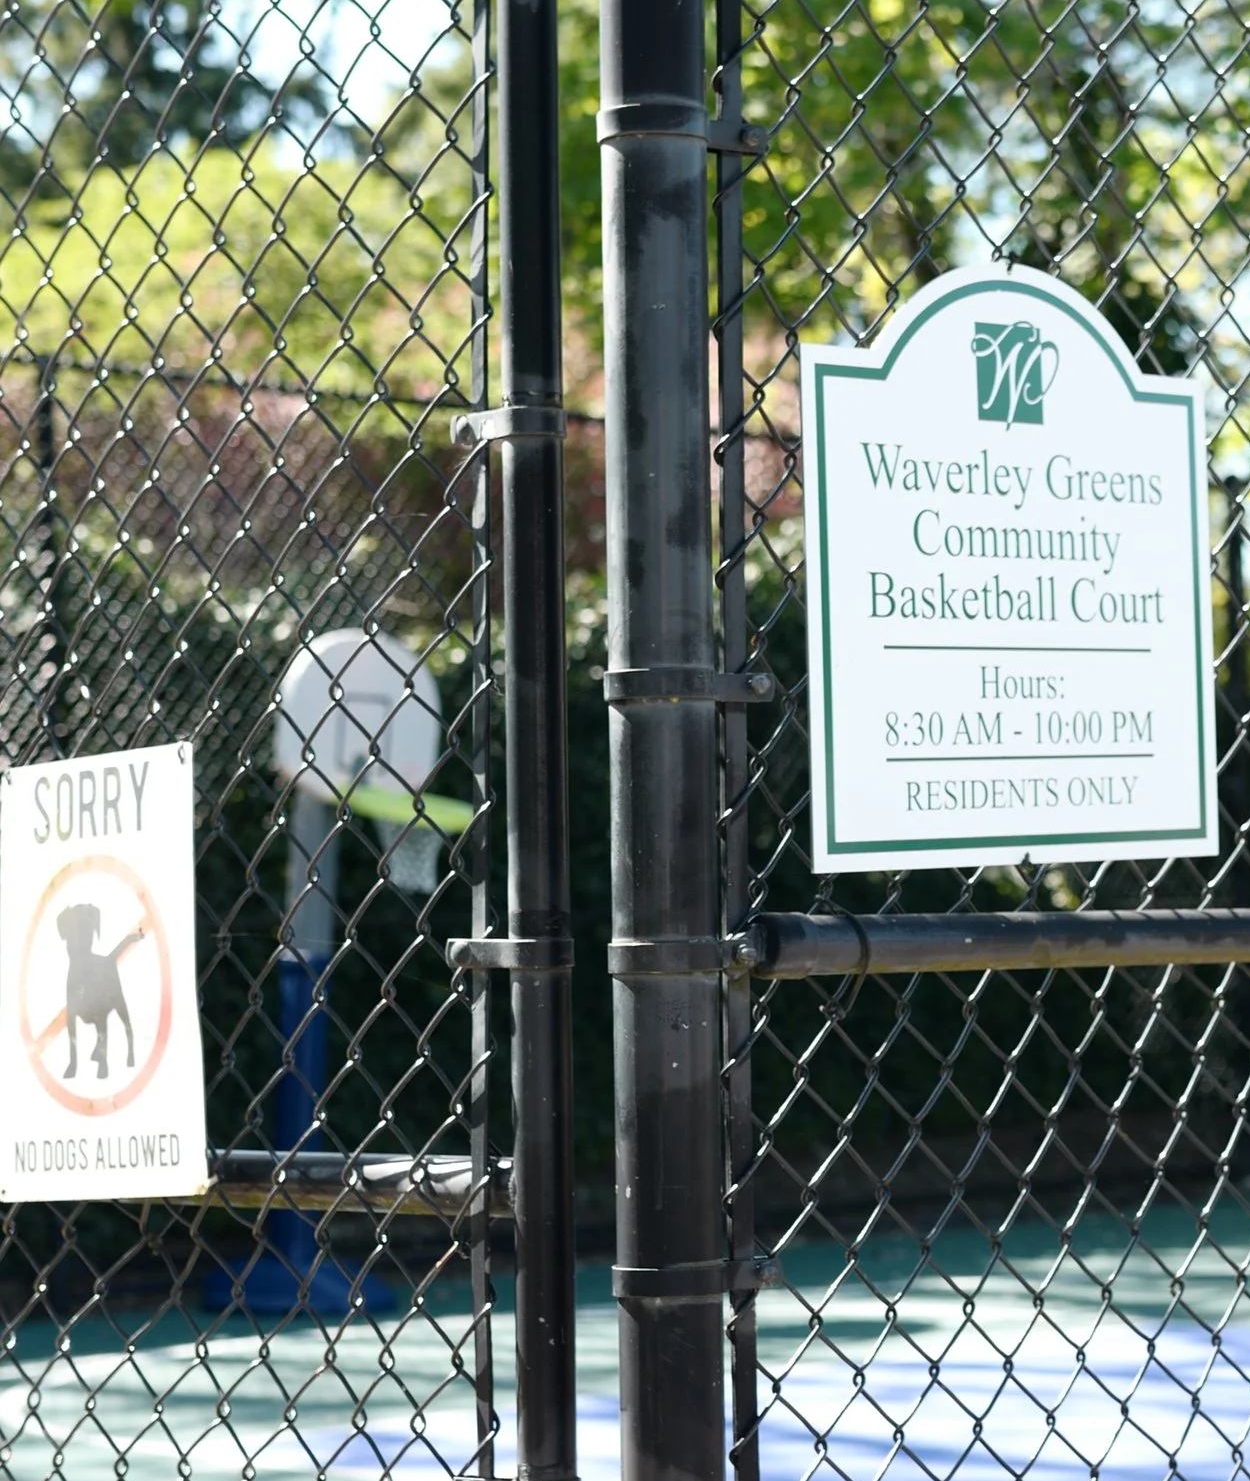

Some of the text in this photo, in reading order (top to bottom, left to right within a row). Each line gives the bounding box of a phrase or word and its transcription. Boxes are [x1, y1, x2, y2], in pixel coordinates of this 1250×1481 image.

[860, 442, 1163, 510] Waverley Greens
[913, 509, 1122, 575] Community
[868, 571, 1165, 625] Basketball Court
[980, 665, 1066, 701] Hours:
[885, 711, 944, 748] 8:30
[952, 712, 1004, 747] AM
[1035, 711, 1102, 746] 10:00
[1111, 710, 1154, 744] PM
[33, 761, 150, 844] SORRY
[906, 775, 1139, 812] RESIDENTS ONLY
[14, 1132, 181, 1174] NO DOGS ALLOWED
